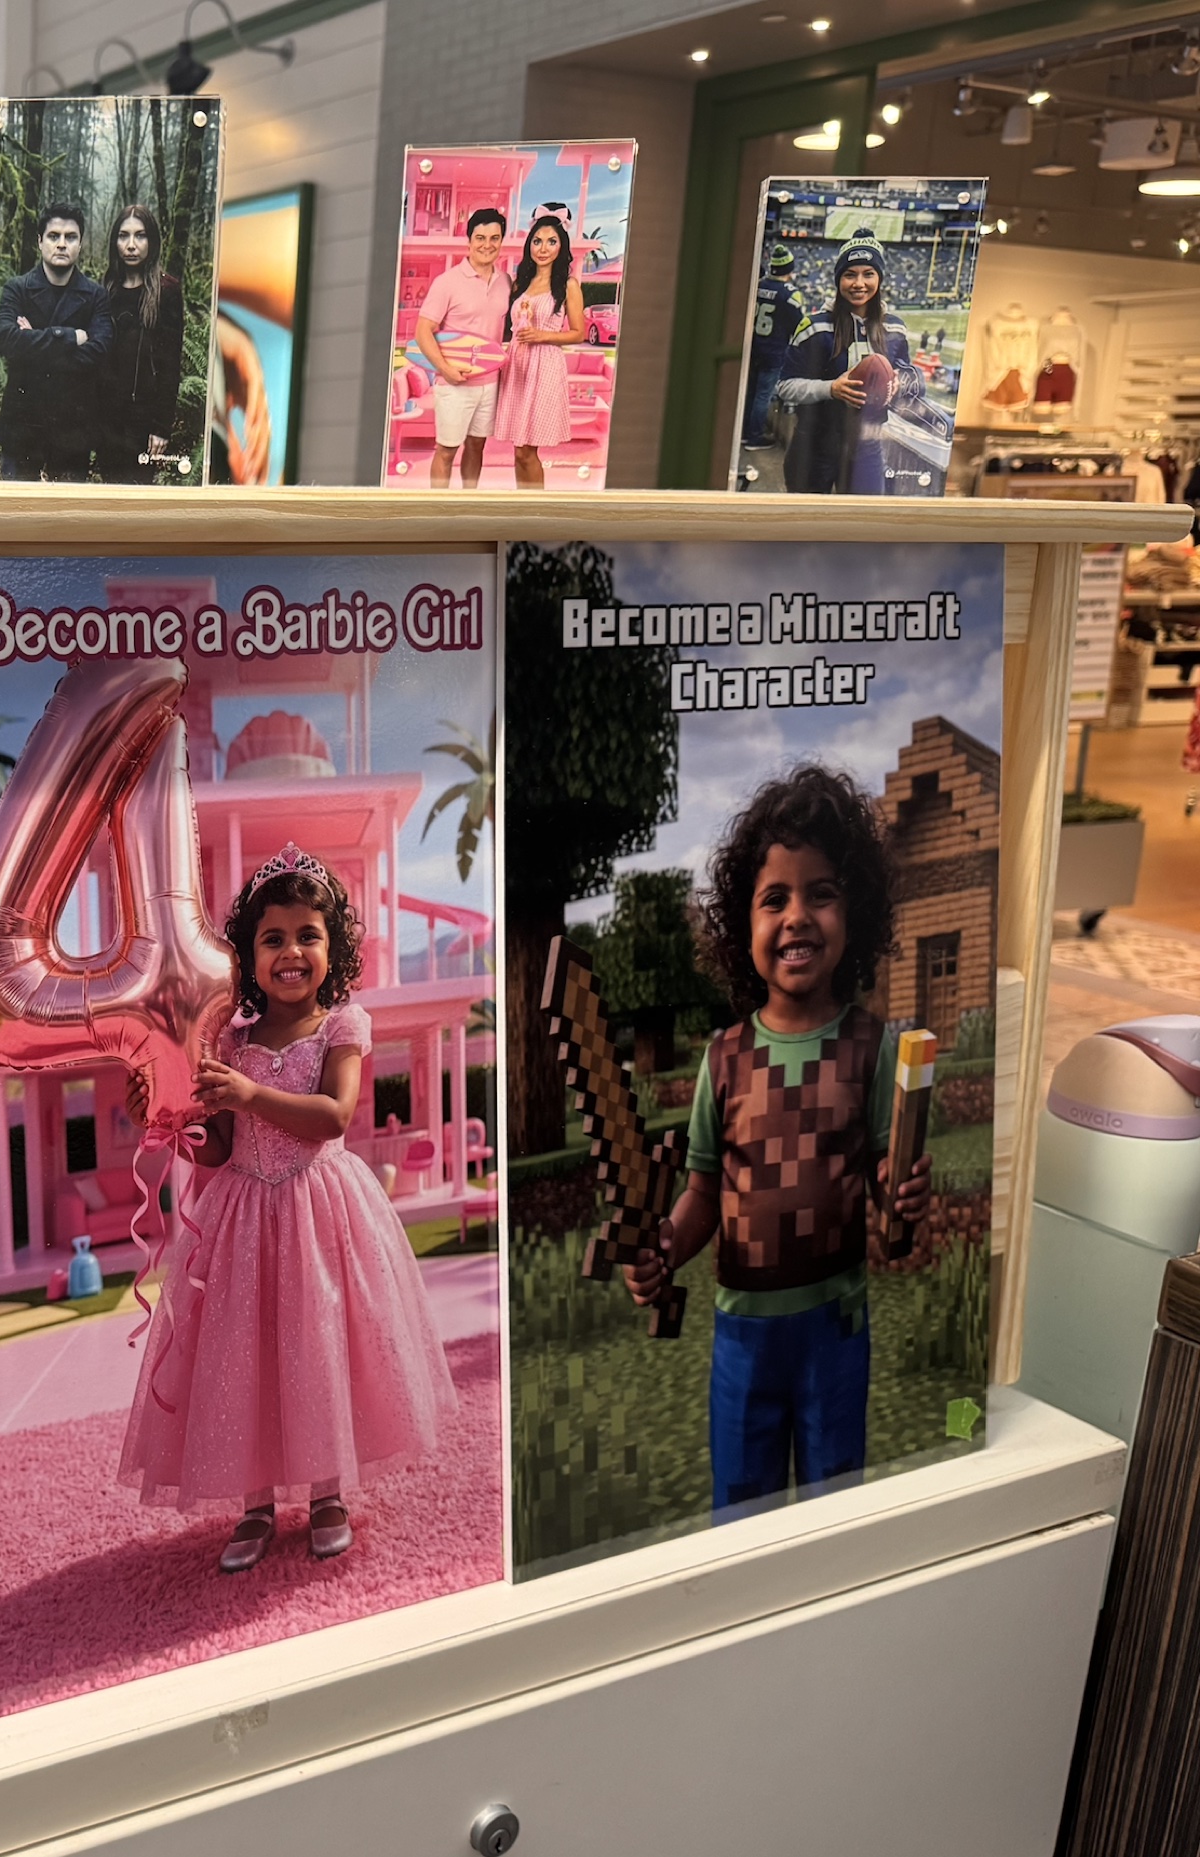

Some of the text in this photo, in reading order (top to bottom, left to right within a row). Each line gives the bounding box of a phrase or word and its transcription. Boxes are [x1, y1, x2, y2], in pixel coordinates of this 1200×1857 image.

[755, 303, 776, 336] 6
[197, 604, 226, 656] a
[235, 586, 396, 656] Barbie
[404, 584, 483, 651] Girl
[561, 592, 961, 649] Become a Minecraft
[671, 657, 875, 711] Character
[1070, 1107, 1123, 1128] owala
